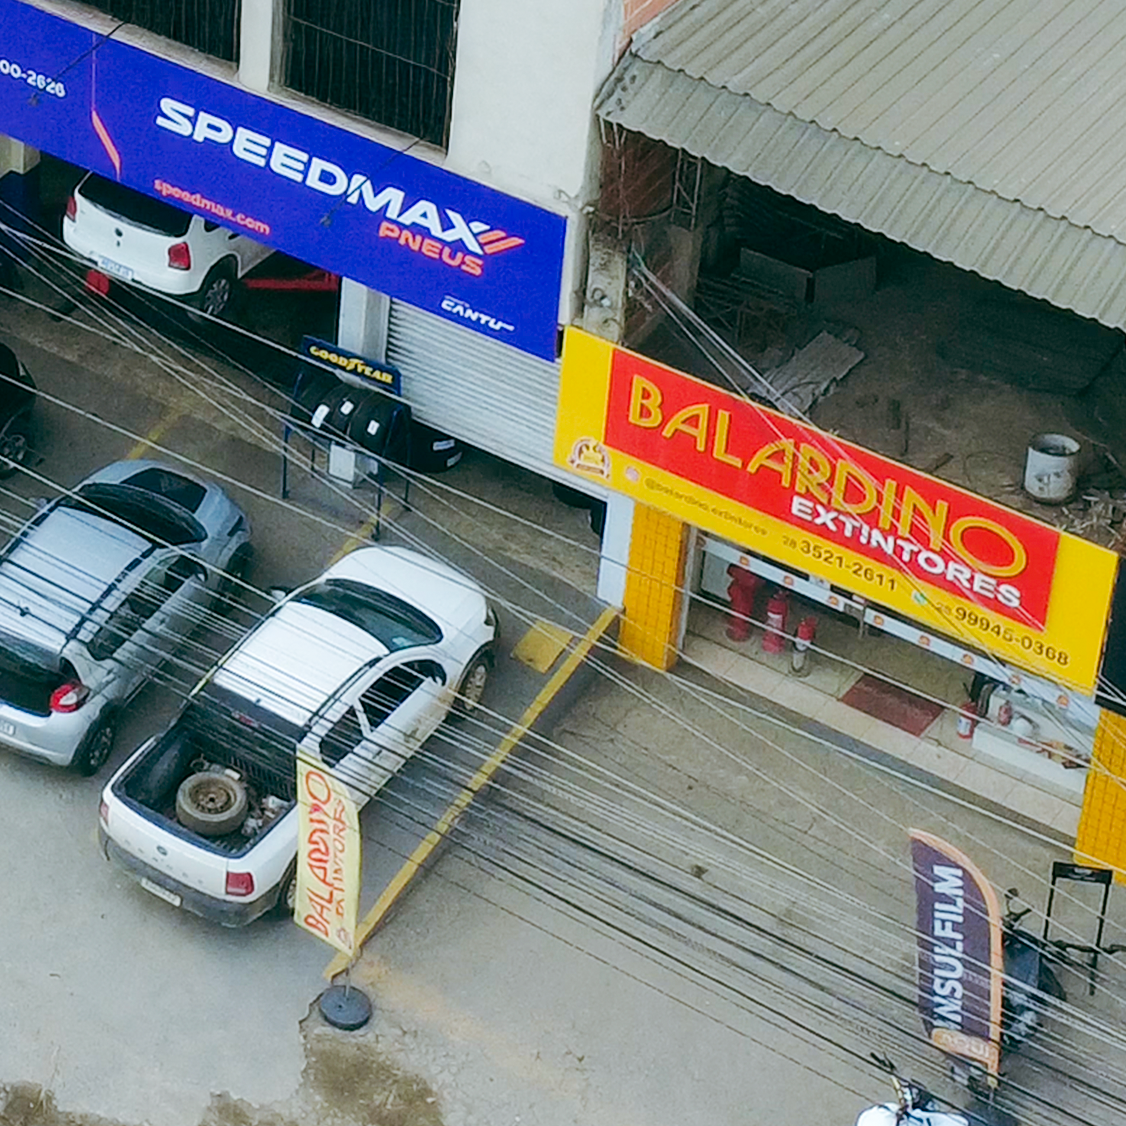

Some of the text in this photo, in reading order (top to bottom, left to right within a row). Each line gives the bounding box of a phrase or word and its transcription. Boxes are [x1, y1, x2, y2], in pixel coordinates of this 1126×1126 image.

[155, 96, 492, 256] SPEEDMAX
[154, 179, 270, 235] speedmax.com
[378, 220, 484, 277] PNEUS
[309, 346, 394, 384] GOODYEAR
[626, 373, 1030, 578] BALARDINO
[791, 495, 1023, 609] EXTINTORES
[800, 539, 896, 591] 3521-2611
